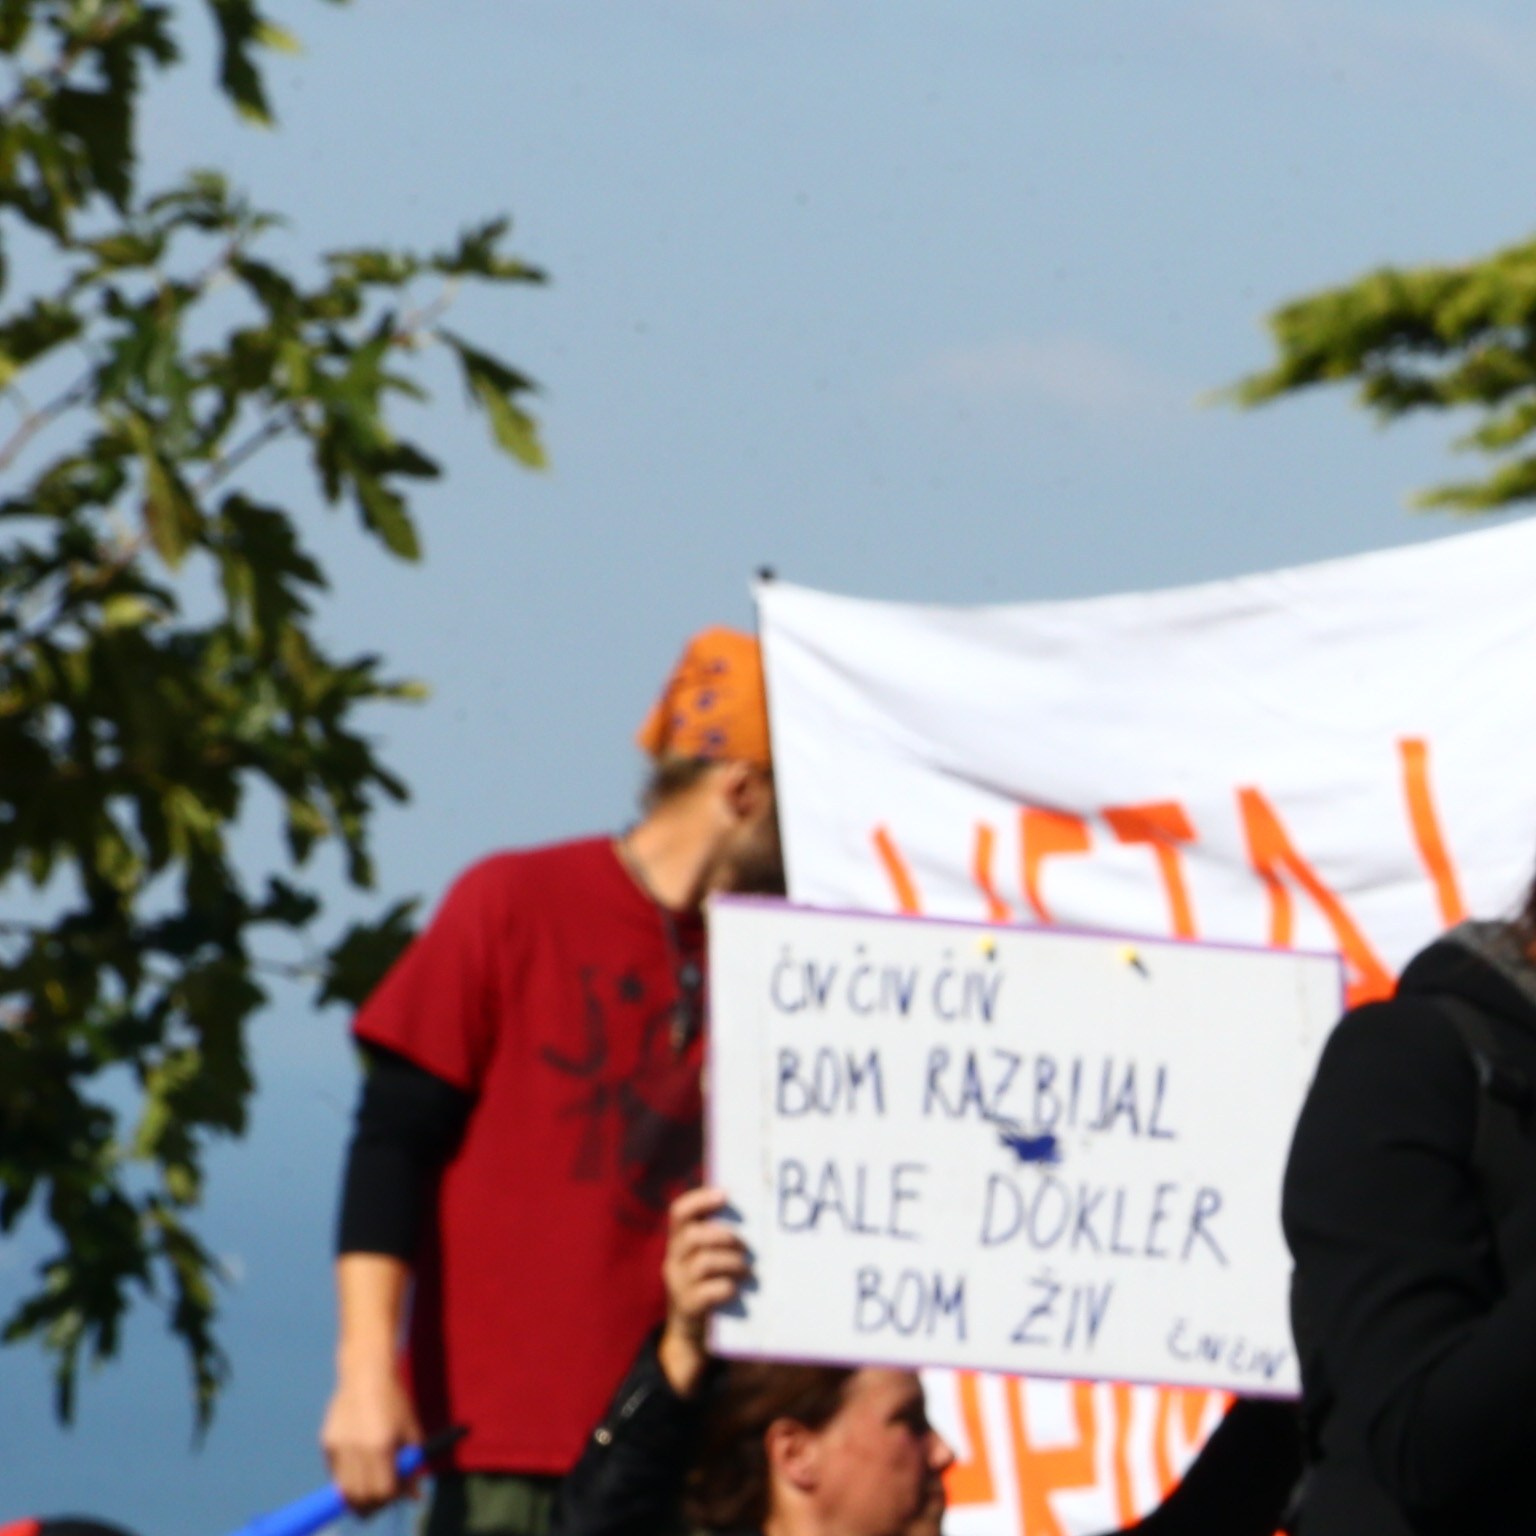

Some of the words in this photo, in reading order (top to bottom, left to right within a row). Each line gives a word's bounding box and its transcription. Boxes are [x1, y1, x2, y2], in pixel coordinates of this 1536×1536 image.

[775, 1047, 886, 1117] BOM
[922, 1046, 1178, 1142] RAZBIJAL
[777, 1159, 926, 1241] BALE
[979, 1165, 1228, 1268] DOKLER
[855, 1267, 968, 1343] BOM
[1009, 1270, 1115, 1350] ŽIV
